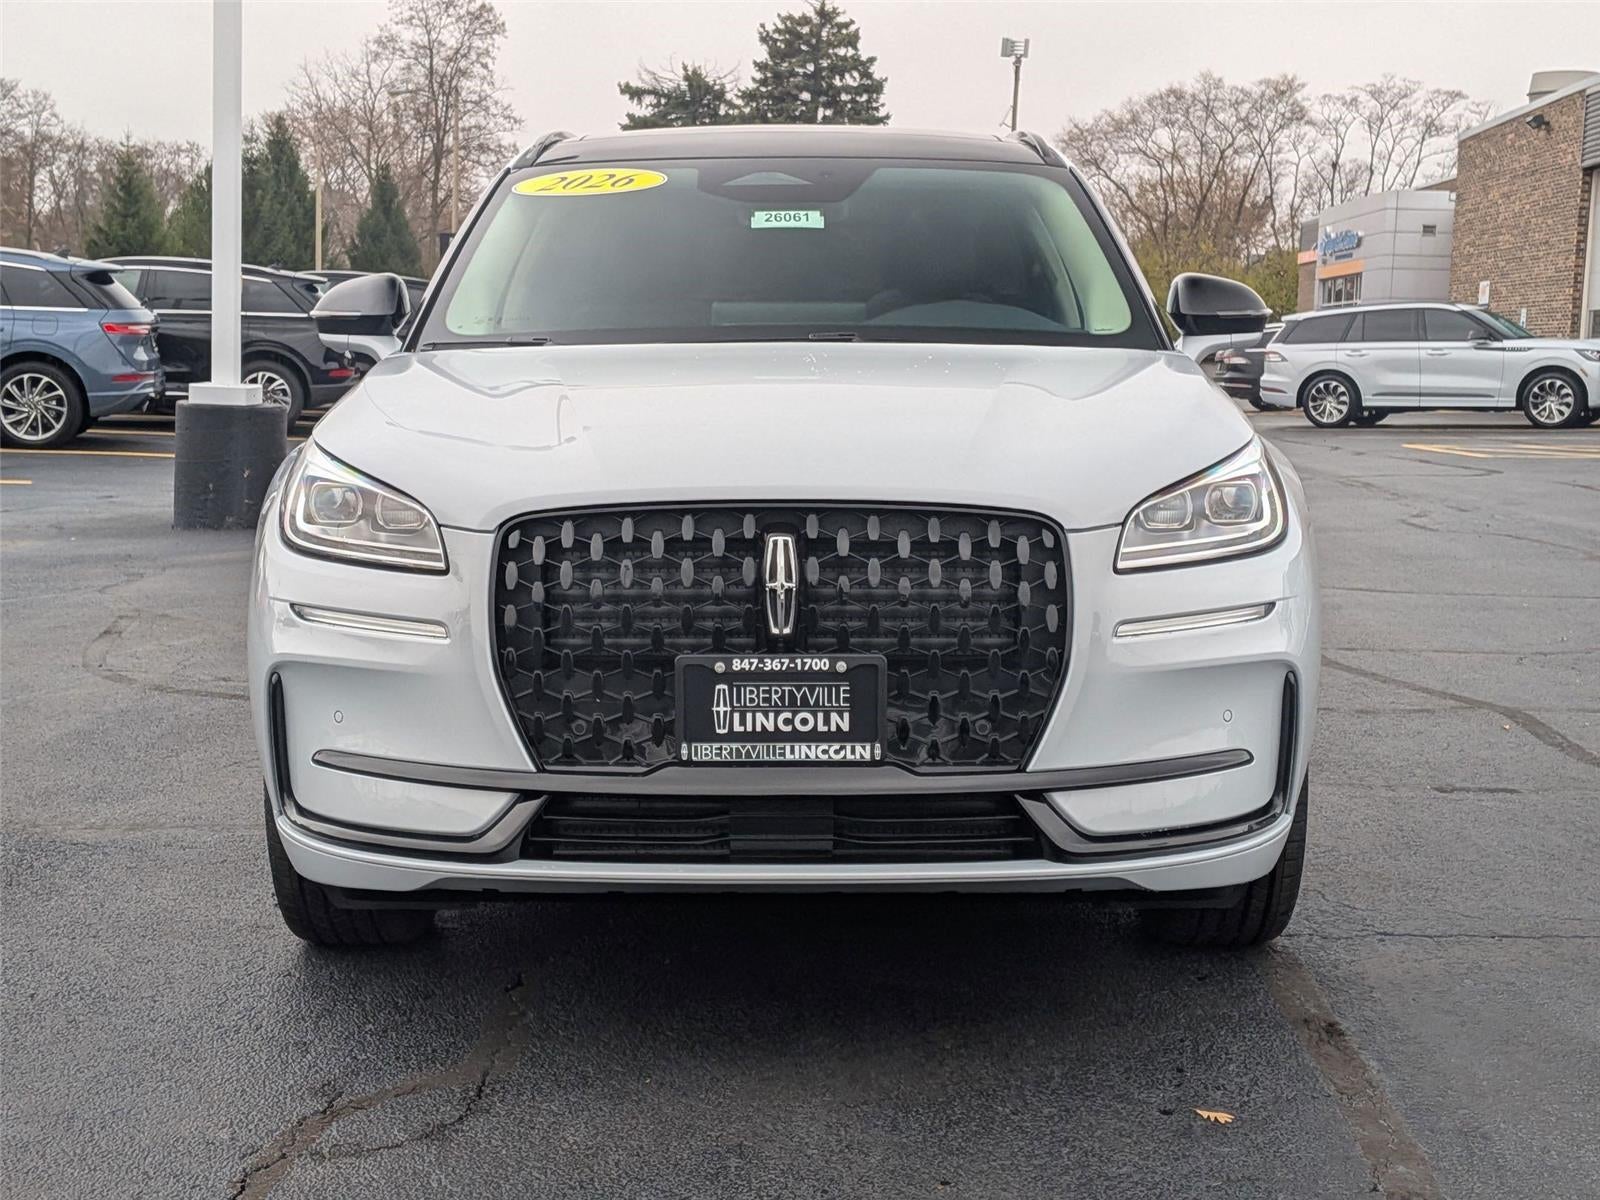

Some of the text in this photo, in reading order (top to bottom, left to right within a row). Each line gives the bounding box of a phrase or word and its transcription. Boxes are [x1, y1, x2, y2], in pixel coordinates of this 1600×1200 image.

[535, 173, 641, 192] 2026
[764, 212, 809, 222] 26061
[731, 658, 830, 671] 847-367-1700
[733, 686, 850, 707] LIBERTYVILLE
[733, 711, 850, 732] LINCOLN
